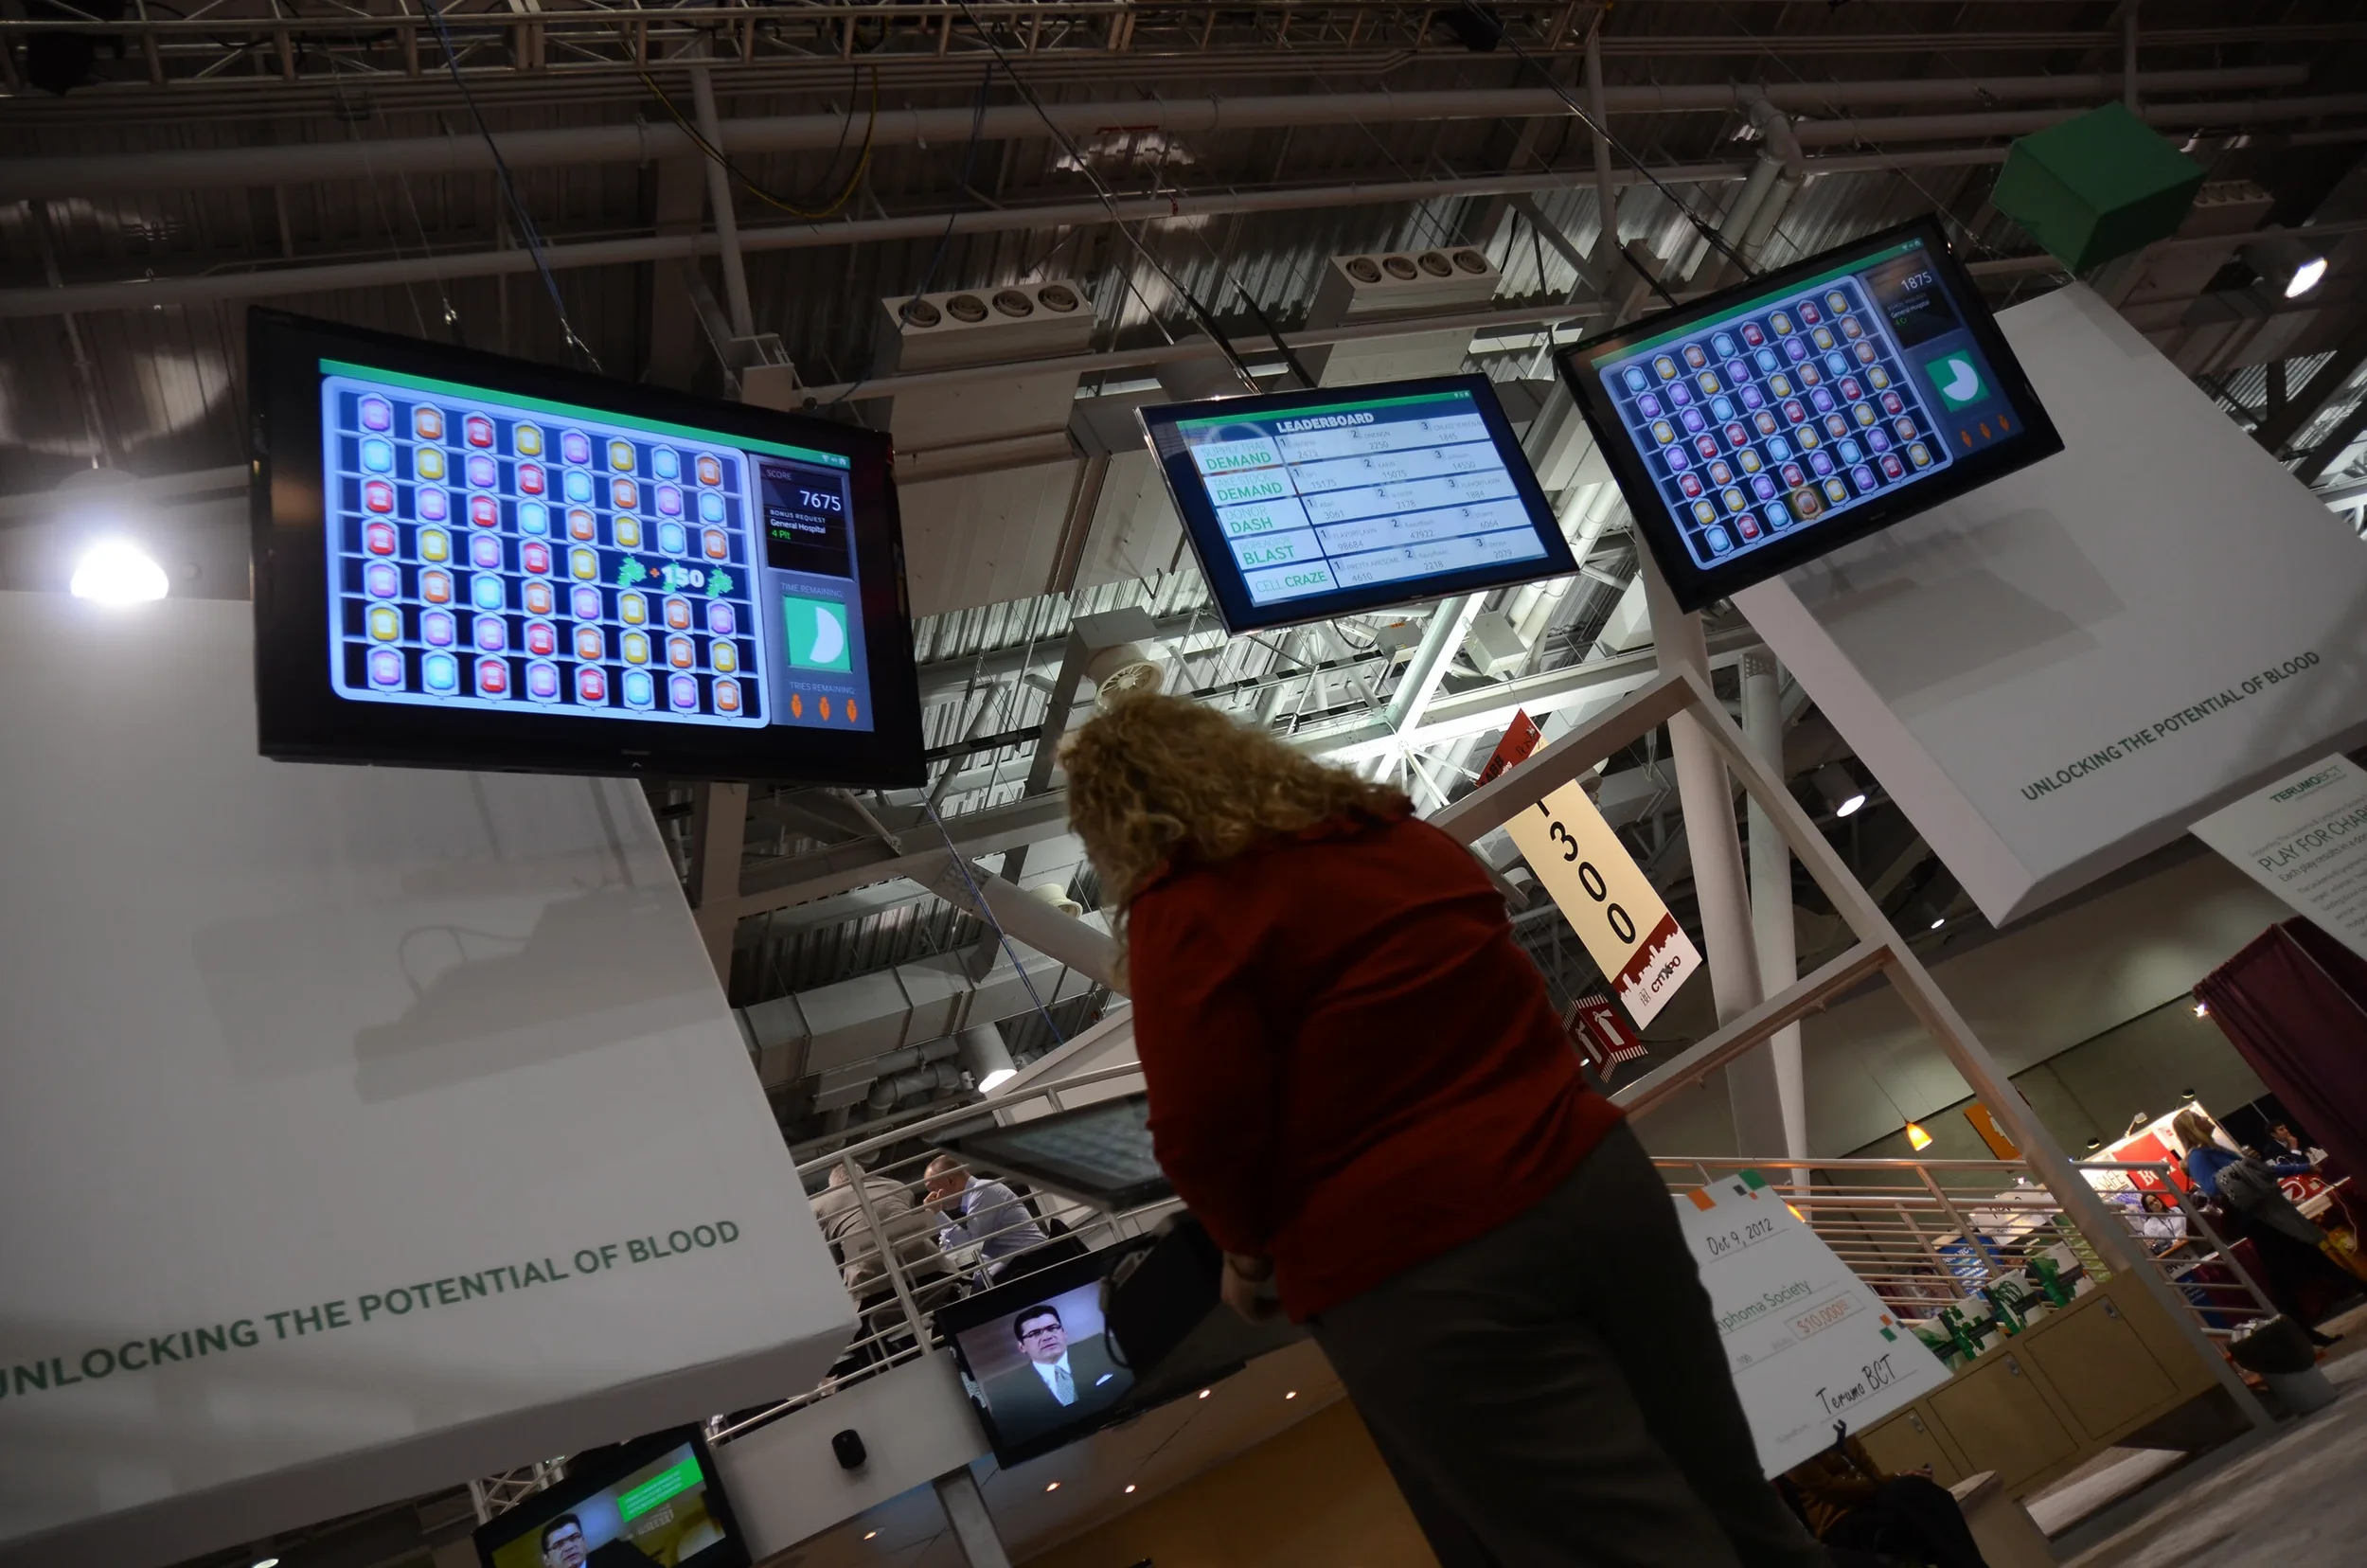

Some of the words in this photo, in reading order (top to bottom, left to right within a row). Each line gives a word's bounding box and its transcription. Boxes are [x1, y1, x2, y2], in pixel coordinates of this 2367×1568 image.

[1901, 272, 1931, 290] 1875
[1276, 413, 1374, 434] LEADERBOARD
[1422, 421, 1429, 430] 3
[1351, 430, 1359, 438] 2
[1201, 443, 1239, 457] SUPPLY
[1242, 440, 1266, 453] THAT
[1280, 438, 1286, 447] 1
[1369, 441, 1389, 451] 2250
[1205, 452, 1272, 470] DEMAND
[1364, 459, 1372, 468] 2
[767, 469, 792, 481] SCORE
[1293, 468, 1300, 477] 1
[1212, 475, 1237, 487] TAKE
[1238, 472, 1271, 485] STOCK
[1449, 479, 1456, 489] 3
[1218, 482, 1283, 502] DEMAND
[1378, 489, 1386, 498] 2
[799, 490, 842, 511] 7675
[1307, 498, 1313, 508] 1
[770, 509, 793, 519] BONUS
[795, 513, 826, 523] REQUEST
[1225, 506, 1268, 521] DONOR
[771, 519, 797, 530] General
[799, 523, 826, 534] Hospital
[1231, 517, 1273, 534] DASH
[1392, 519, 1399, 528] 2
[1320, 529, 1327, 538] 1
[1338, 541, 1363, 551] 98684
[1476, 538, 1484, 547] 3
[1242, 545, 1295, 564] BLAST
[1405, 549, 1413, 559] 2
[1334, 561, 1341, 570] 1
[1424, 561, 1444, 570] 2218
[1255, 579, 1281, 594] CELL
[1285, 571, 1327, 587] CRAZE
[1352, 572, 1373, 581] 4610
[781, 581, 799, 593] TIME
[790, 681, 810, 691] TRIES
[2020, 746, 2123, 801] UNLOCKING
[2117, 729, 2157, 754] THE
[2153, 689, 2245, 737] POTENTIAL
[2241, 676, 2264, 695] OF
[2263, 651, 2320, 686] BLOOD
[2258, 845, 2300, 872] PLAY
[2296, 829, 2333, 852] FOR
[1706, 1236, 1730, 1256] Oct
[1731, 1231, 1747, 1247] 9,
[1746, 1218, 1773, 1239] 2012
[264, 1300, 351, 1340] THE
[359, 1256, 570, 1322] POTENTIAL
[574, 1244, 617, 1274] OF
[626, 1221, 739, 1263] BLOOD
[1763, 1280, 1812, 1307] Society
[1816, 1383, 1865, 1415] Terumo
[1861, 1353, 1895, 1390] BCT
